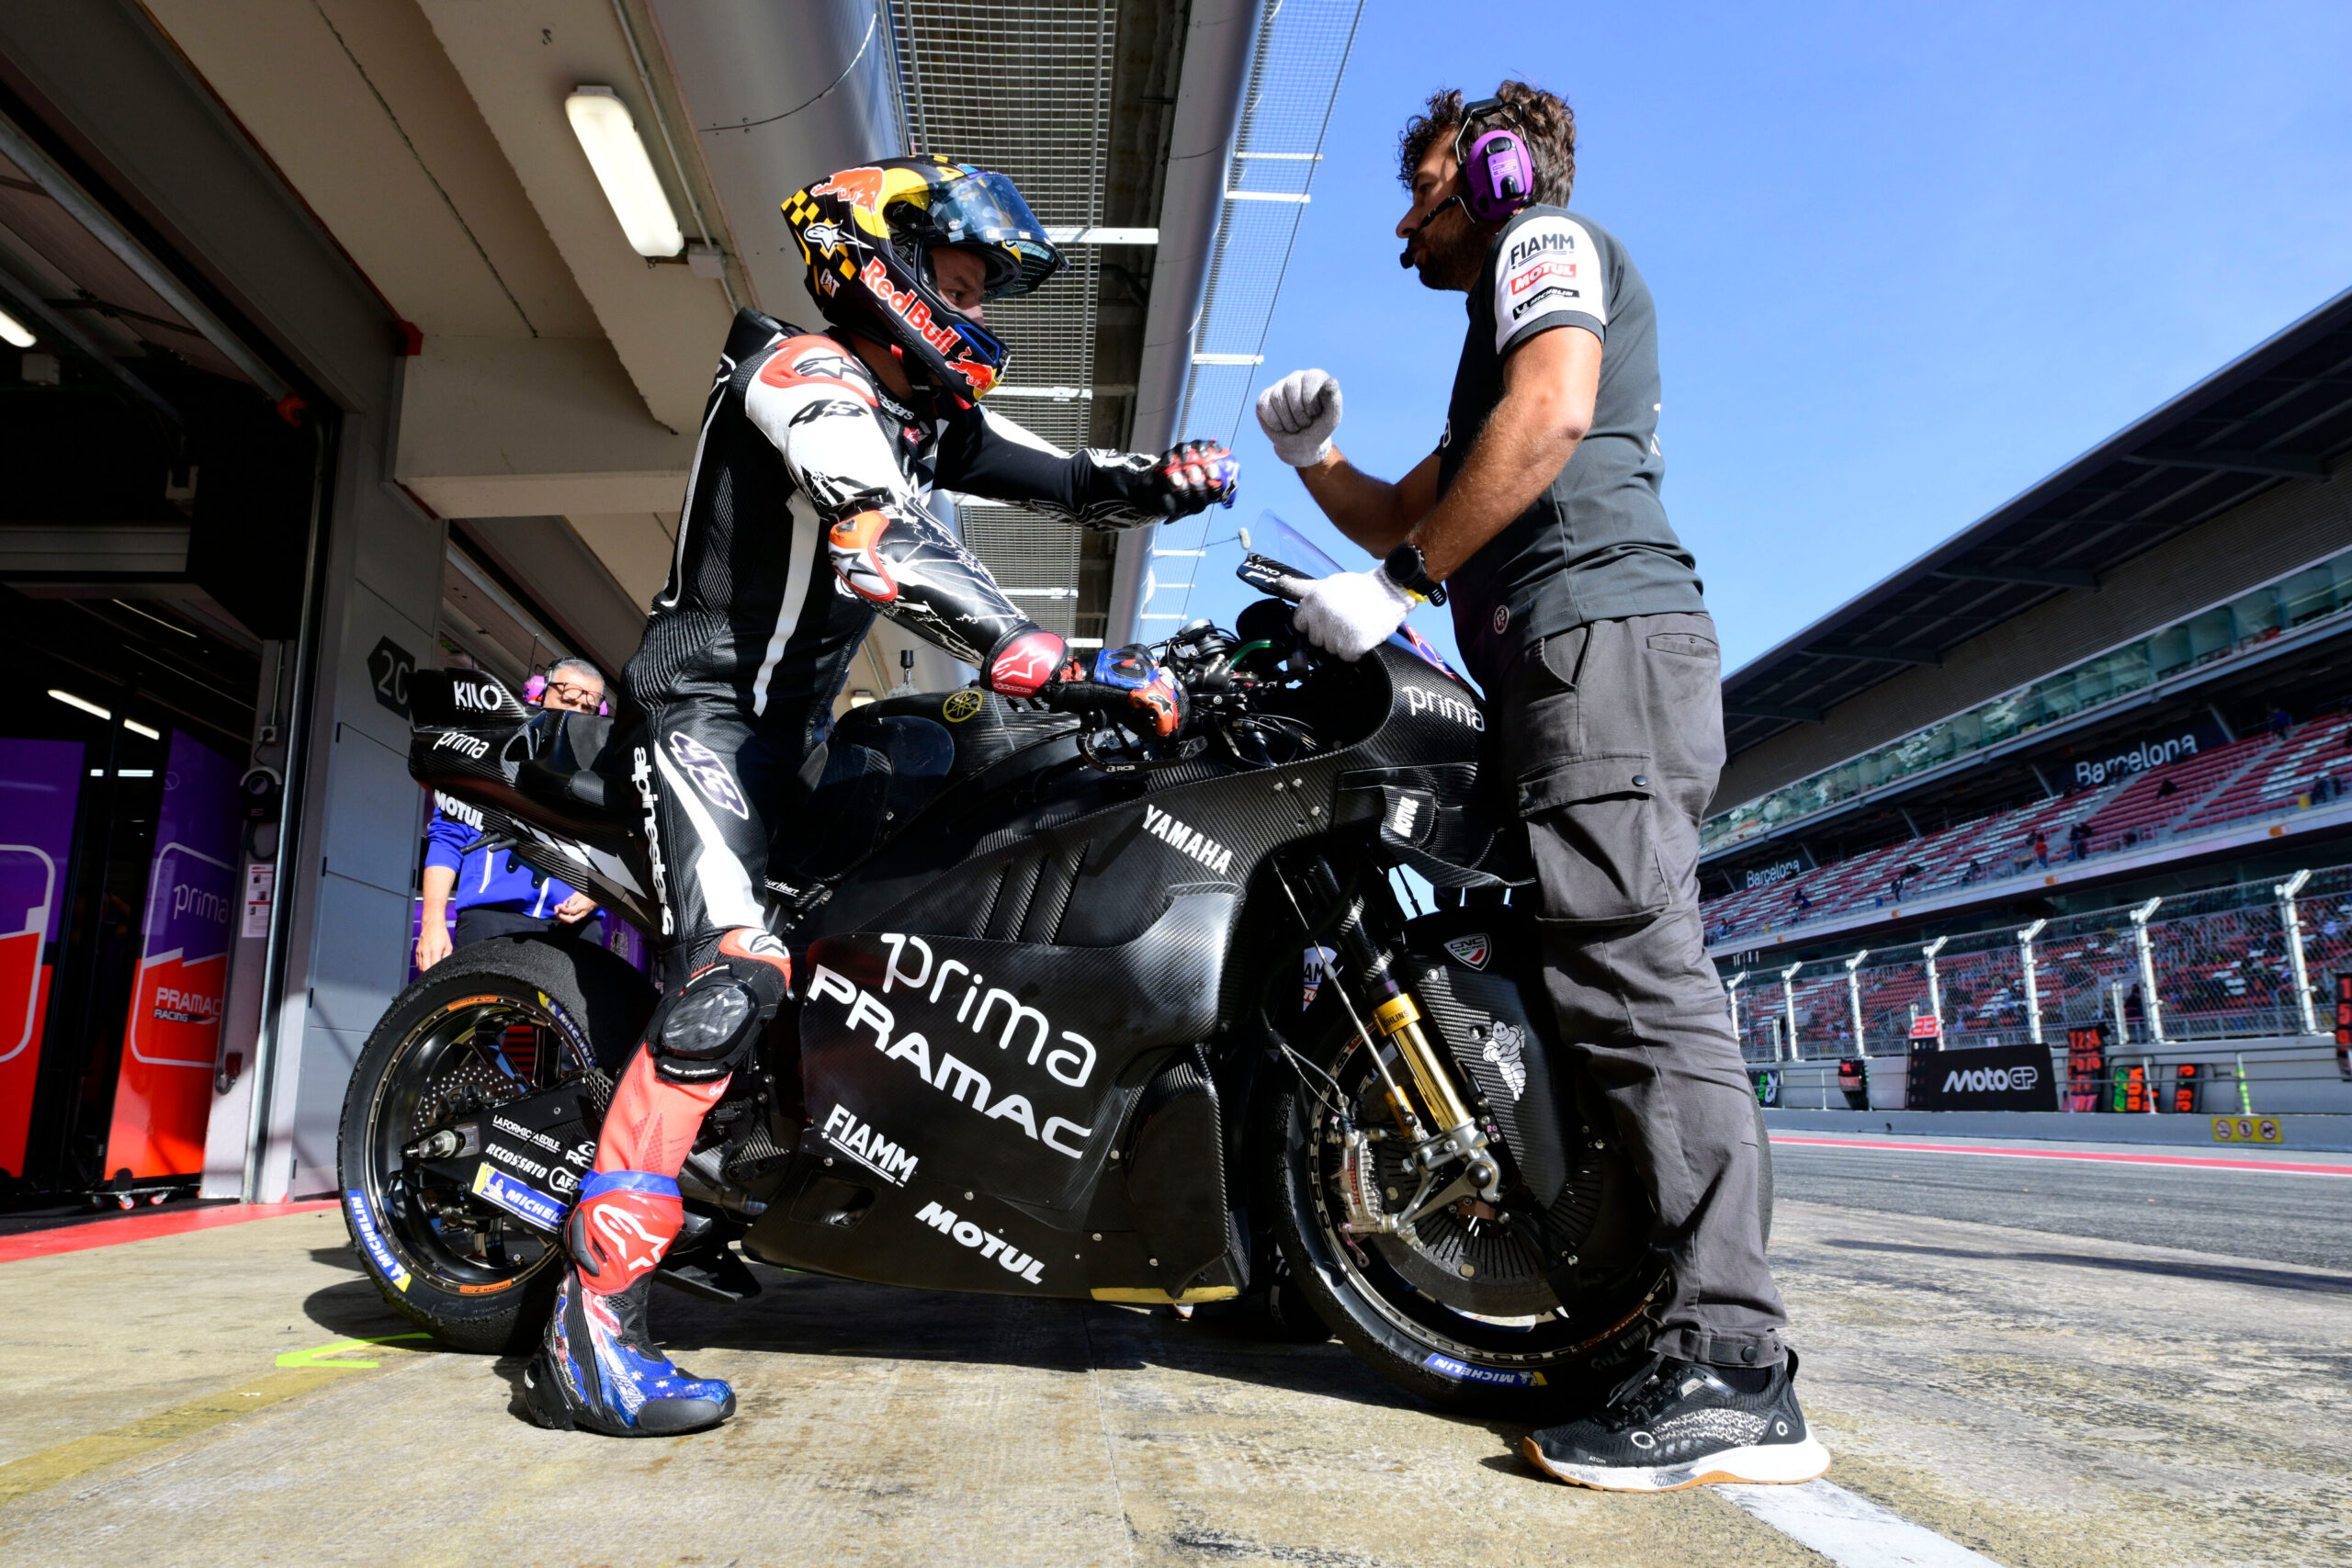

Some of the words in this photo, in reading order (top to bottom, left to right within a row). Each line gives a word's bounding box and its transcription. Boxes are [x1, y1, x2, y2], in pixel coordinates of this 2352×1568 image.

[1510, 233, 1575, 265] FIAMM
[820, 267, 841, 299] CAT
[1514, 264, 1574, 292] MOTUL
[860, 256, 915, 316] Red
[903, 299, 961, 355] Bull
[1243, 561, 1281, 576] LINO
[377, 649, 409, 705] 20
[453, 680, 503, 711] KILO
[1402, 685, 1486, 732] prima
[433, 732, 490, 759] prima
[2075, 734, 2199, 786] Barcelona
[434, 789, 484, 832] MOTUL
[1393, 796, 1419, 838] MOTUL
[1141, 804, 1234, 874] YAMAHA
[174, 884, 229, 923] prima
[153, 1008, 189, 1022] RACING
[155, 987, 221, 1015] PRAMAC
[880, 932, 1098, 1088] prima
[807, 964, 1092, 1159] PRAMAC
[1942, 1066, 2039, 1093] MotoGP
[565, 1150, 594, 1169] RC
[824, 1103, 919, 1182] FIAMM
[1347, 1156, 1361, 1205] brembo
[505, 1190, 561, 1224] MICHEL
[351, 1196, 393, 1270] MICHELIN
[914, 1201, 1046, 1285] MOTUL
[1434, 1358, 1515, 1383] MICHELIN
[1589, 1455, 1607, 1465] ATOM
